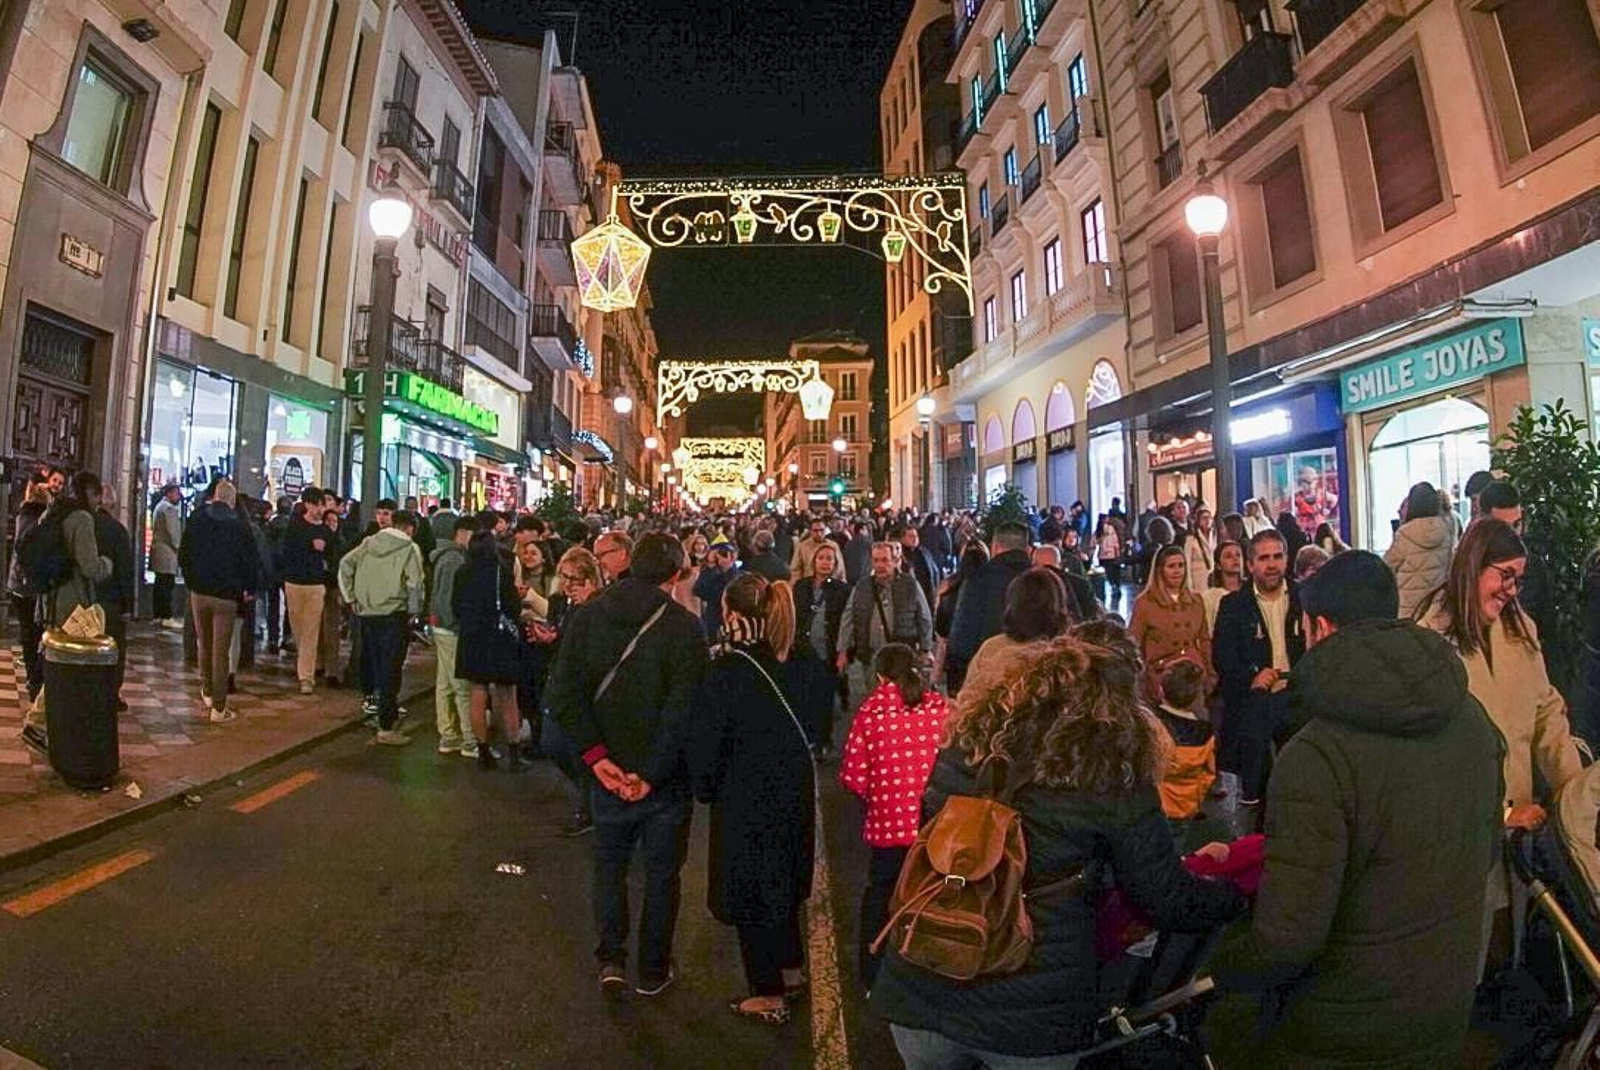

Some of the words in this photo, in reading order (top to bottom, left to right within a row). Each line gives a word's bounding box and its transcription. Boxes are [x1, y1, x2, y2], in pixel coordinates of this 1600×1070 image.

[383, 373, 398, 395] H
[1346, 357, 1415, 403] SMILE
[1423, 329, 1507, 382] JOYAS
[408, 374, 497, 434] FARMACIA
